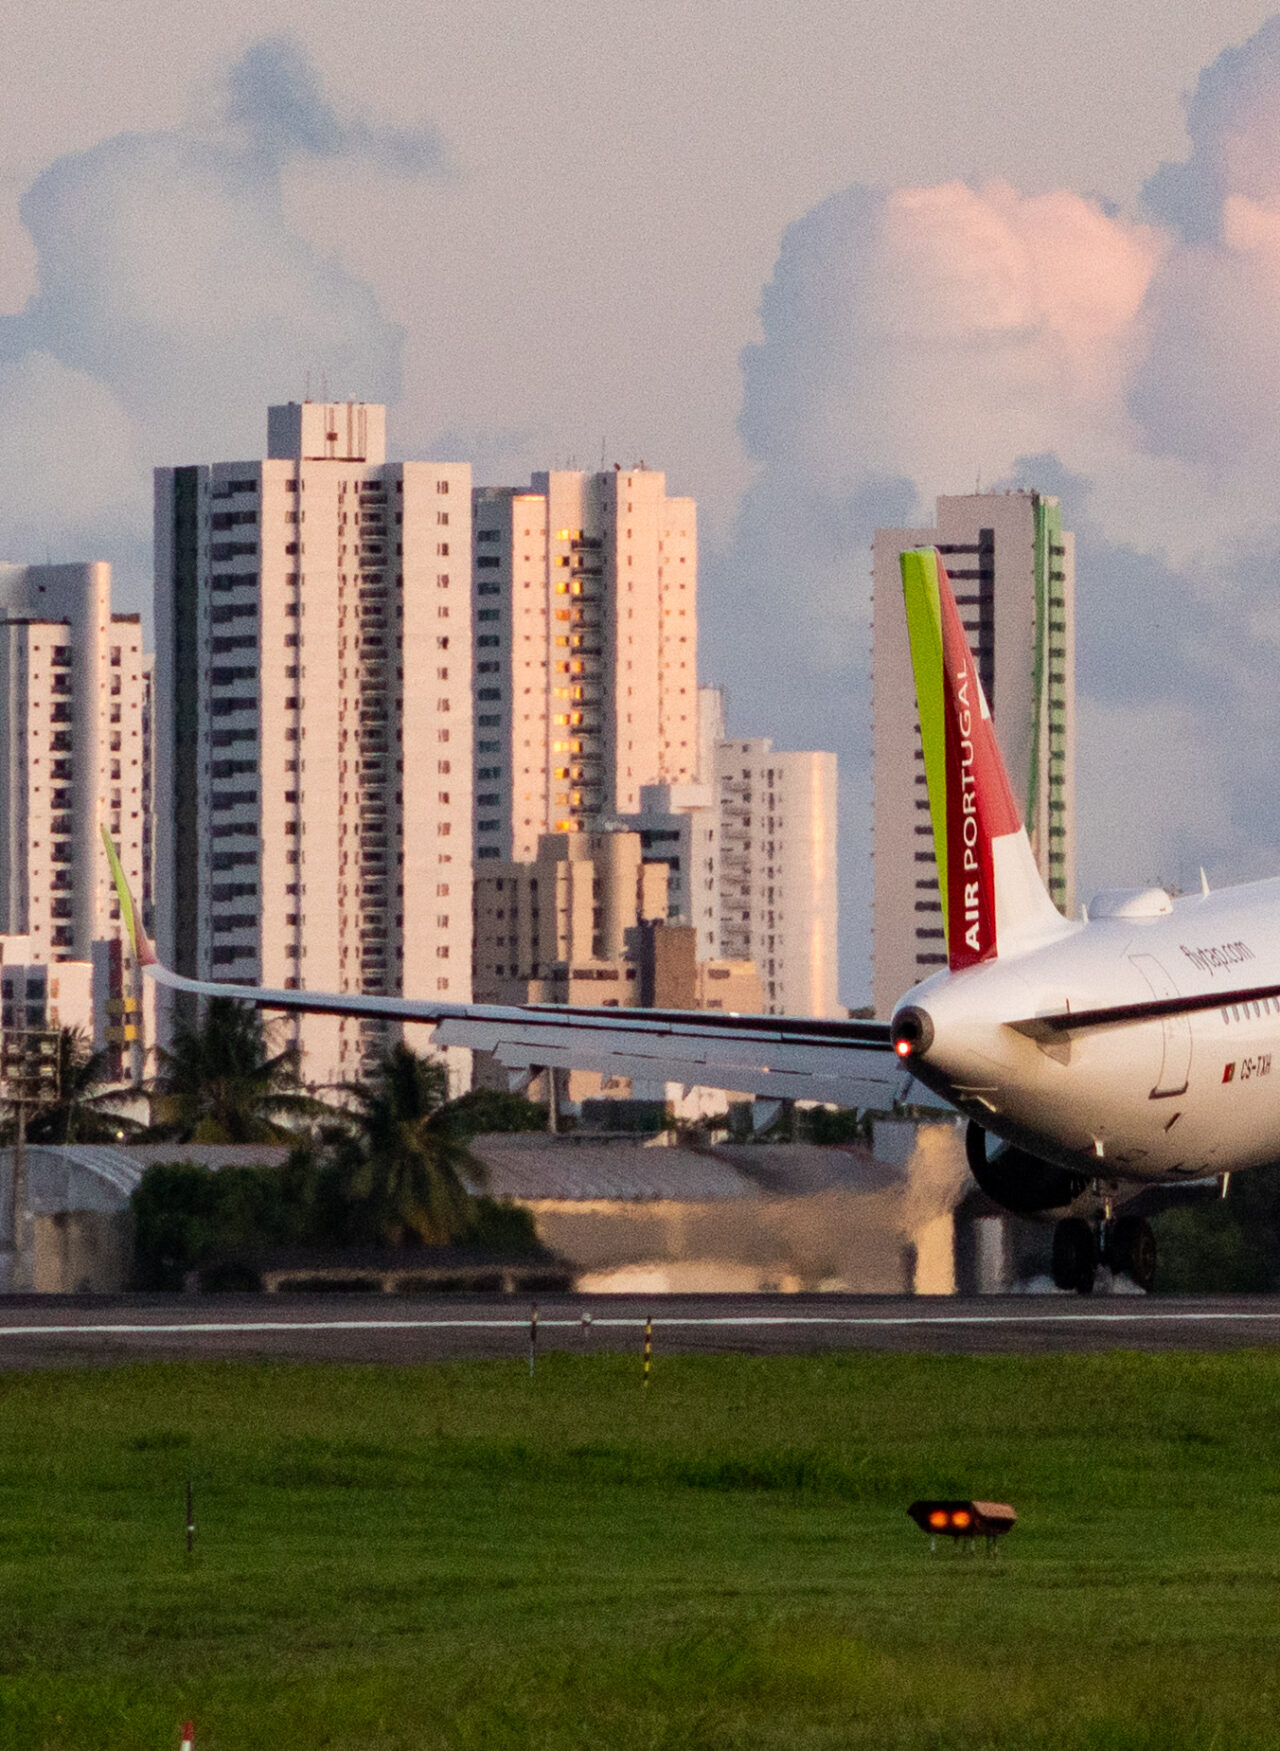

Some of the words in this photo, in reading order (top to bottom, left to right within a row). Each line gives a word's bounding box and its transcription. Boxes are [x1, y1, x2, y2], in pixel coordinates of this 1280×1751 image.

[957, 658, 978, 870] PORTUGAL
[964, 881, 980, 951] AIR
[1178, 941, 1257, 976] flytap.com
